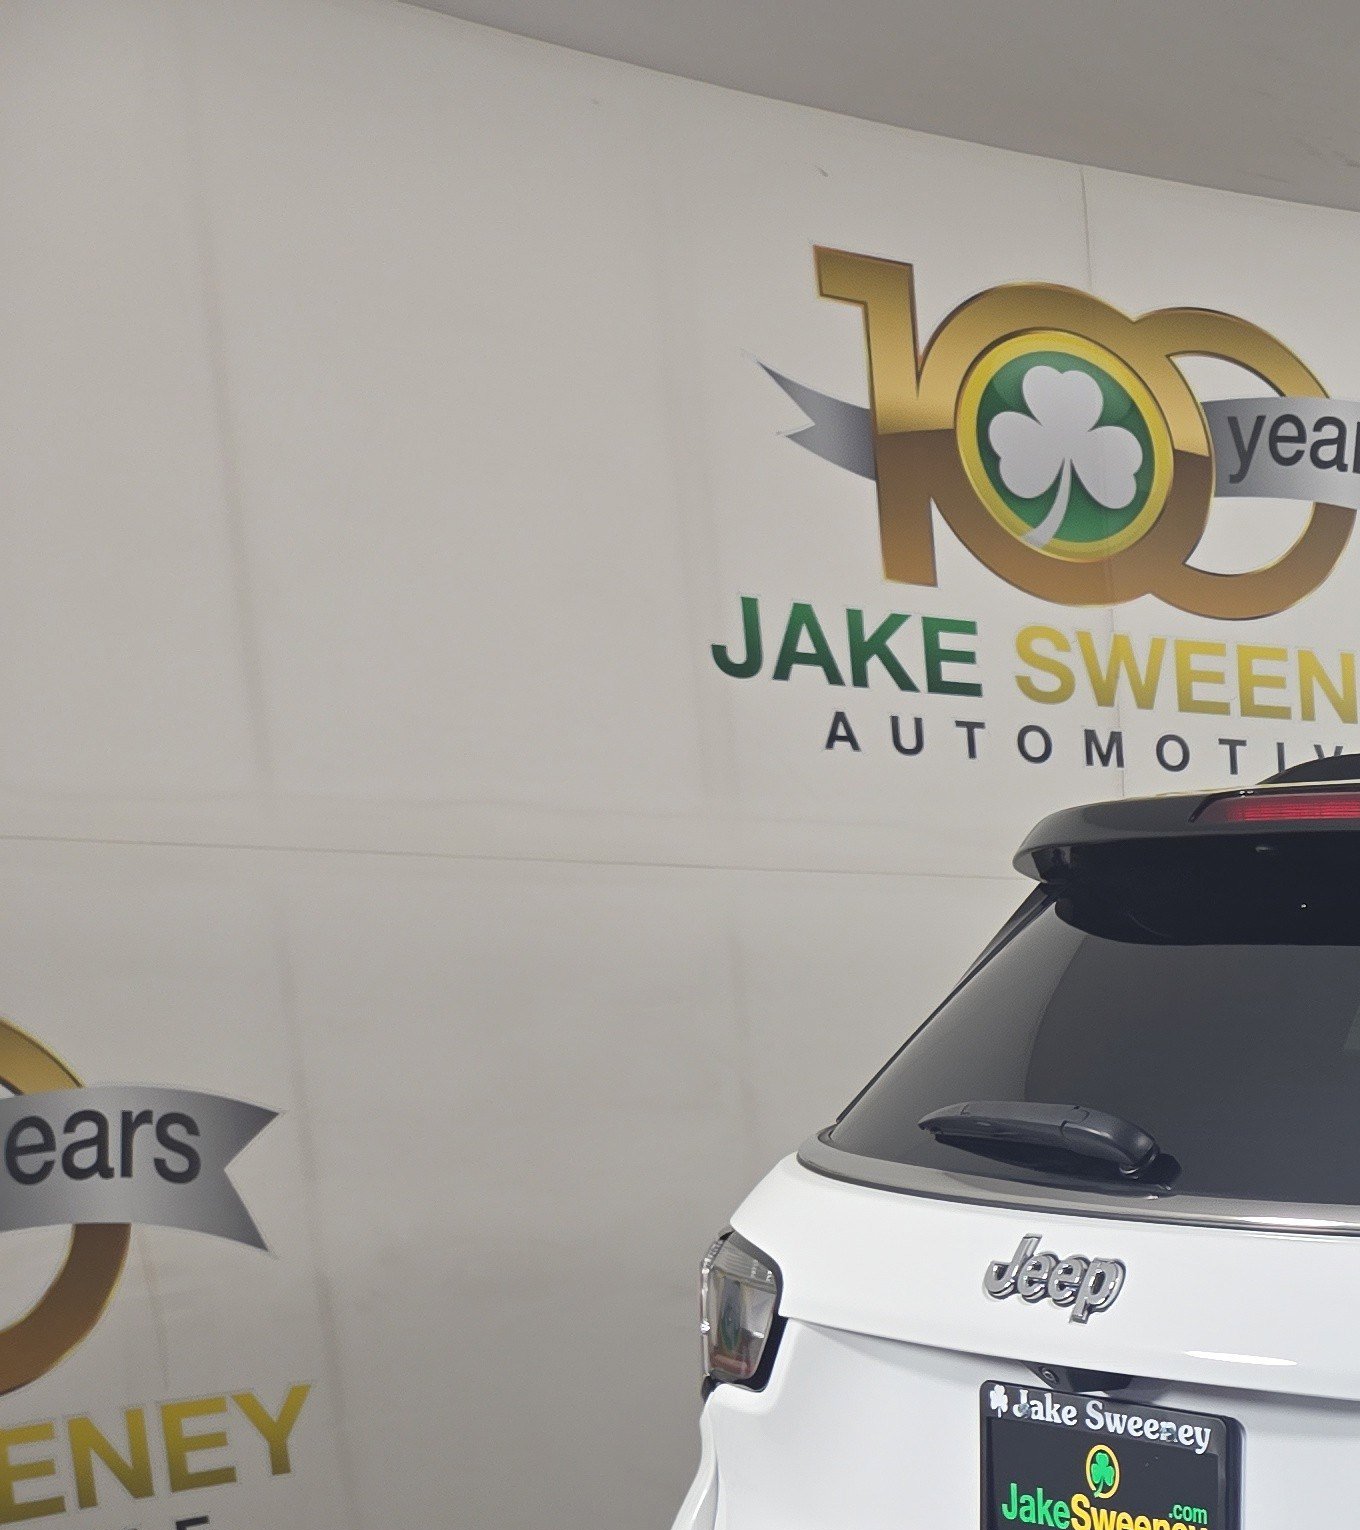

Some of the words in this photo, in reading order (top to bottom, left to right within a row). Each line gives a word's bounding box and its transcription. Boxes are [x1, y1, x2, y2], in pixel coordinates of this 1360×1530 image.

[813, 245, 1356, 620] 100
[711, 596, 983, 698] JAKE
[2, 1109, 201, 1184] ears
[983, 1233, 1126, 1324] Jeep
[0, 1384, 312, 1525] ENEY
[1012, 1390, 1078, 1426] Jake
[1085, 1401, 1211, 1455] Sweeney
